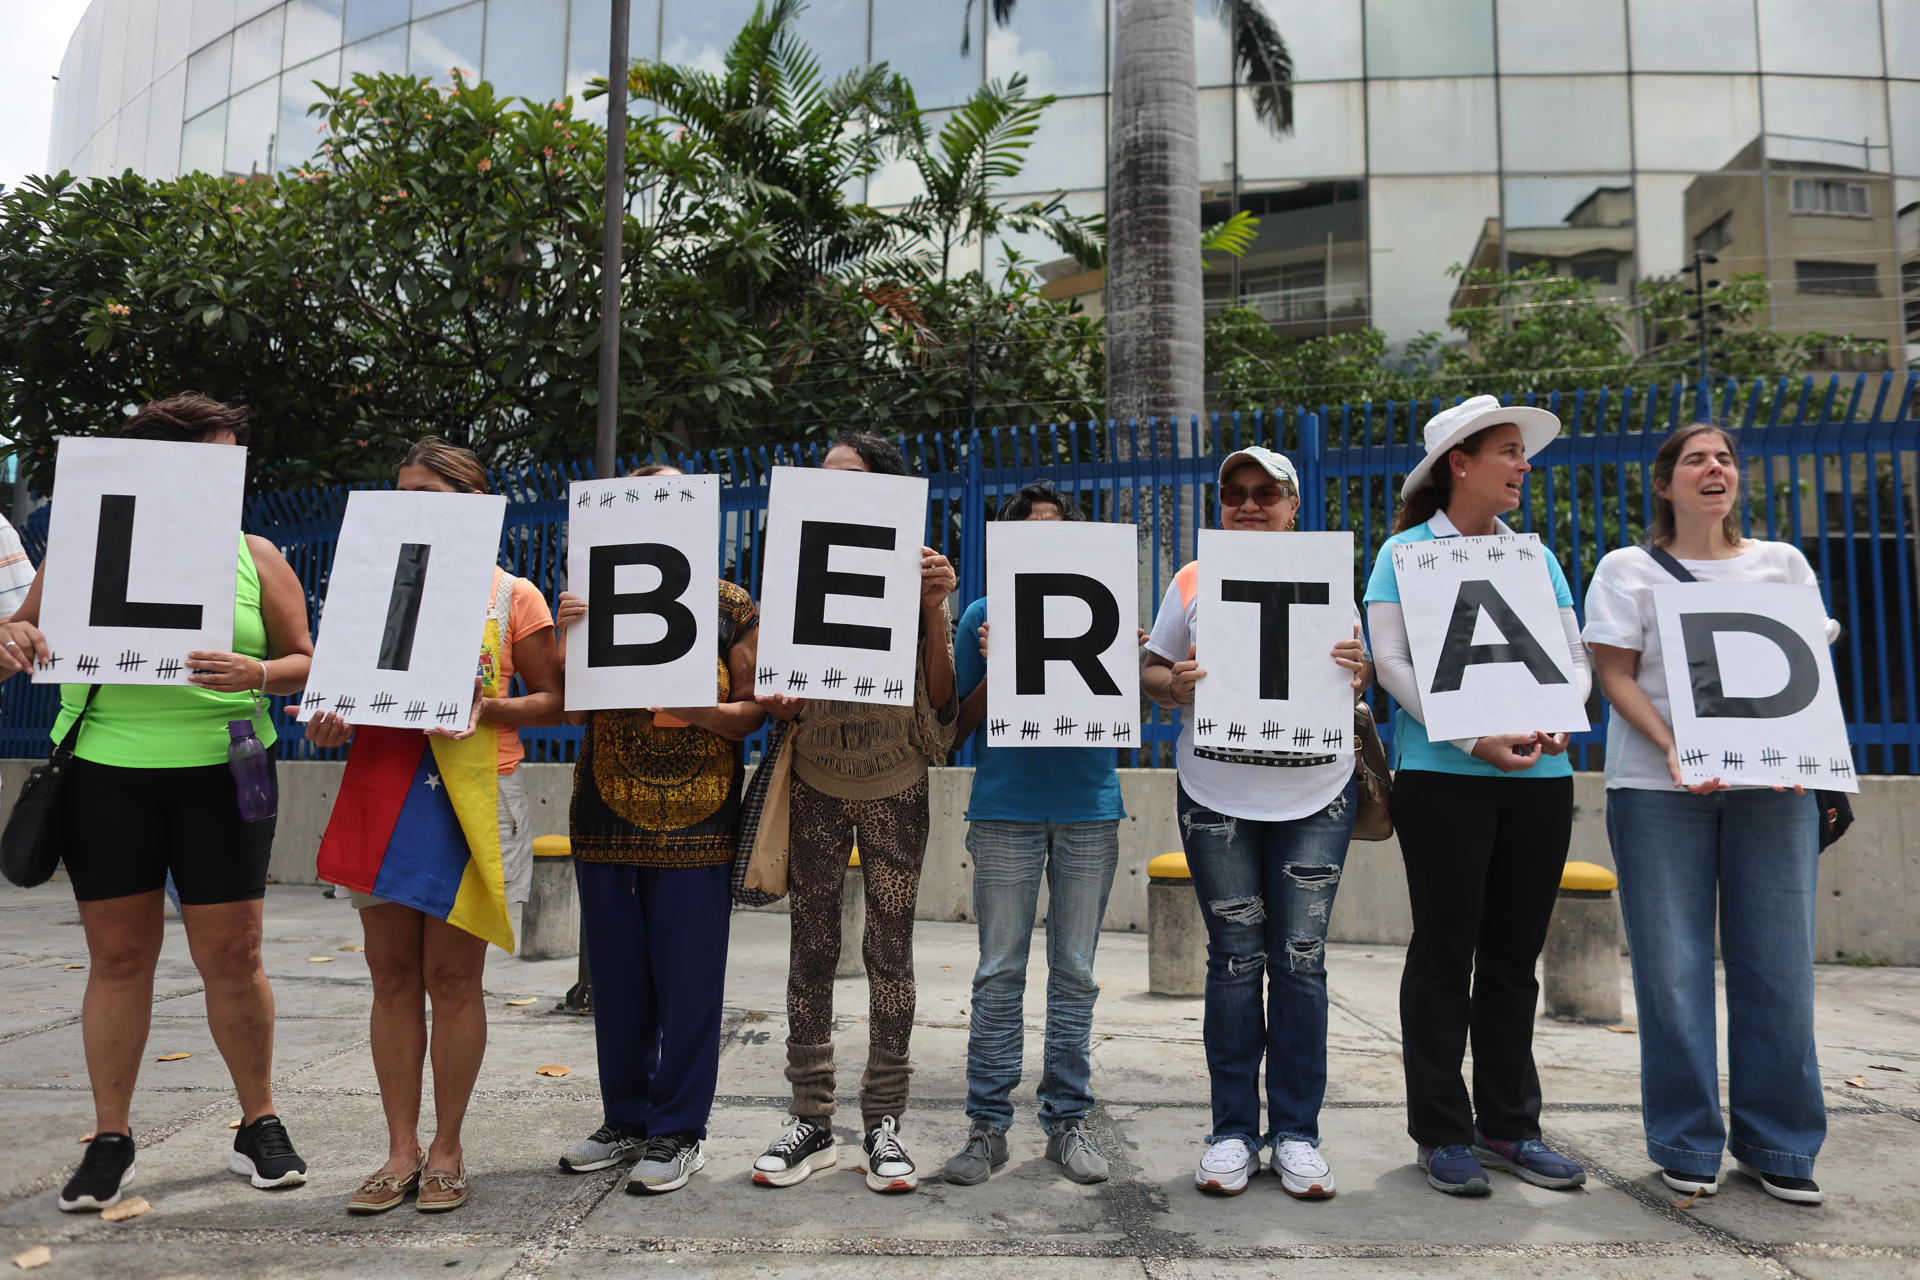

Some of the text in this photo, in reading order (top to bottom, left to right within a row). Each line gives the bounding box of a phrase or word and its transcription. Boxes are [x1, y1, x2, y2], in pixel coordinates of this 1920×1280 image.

[89, 495, 203, 630] L
[377, 543, 431, 671] I
[588, 543, 698, 668] B
[793, 521, 897, 651] E
[1015, 573, 1122, 696] R
[1222, 580, 1329, 700] T
[1430, 580, 1569, 693] A
[1680, 612, 1820, 718] D
